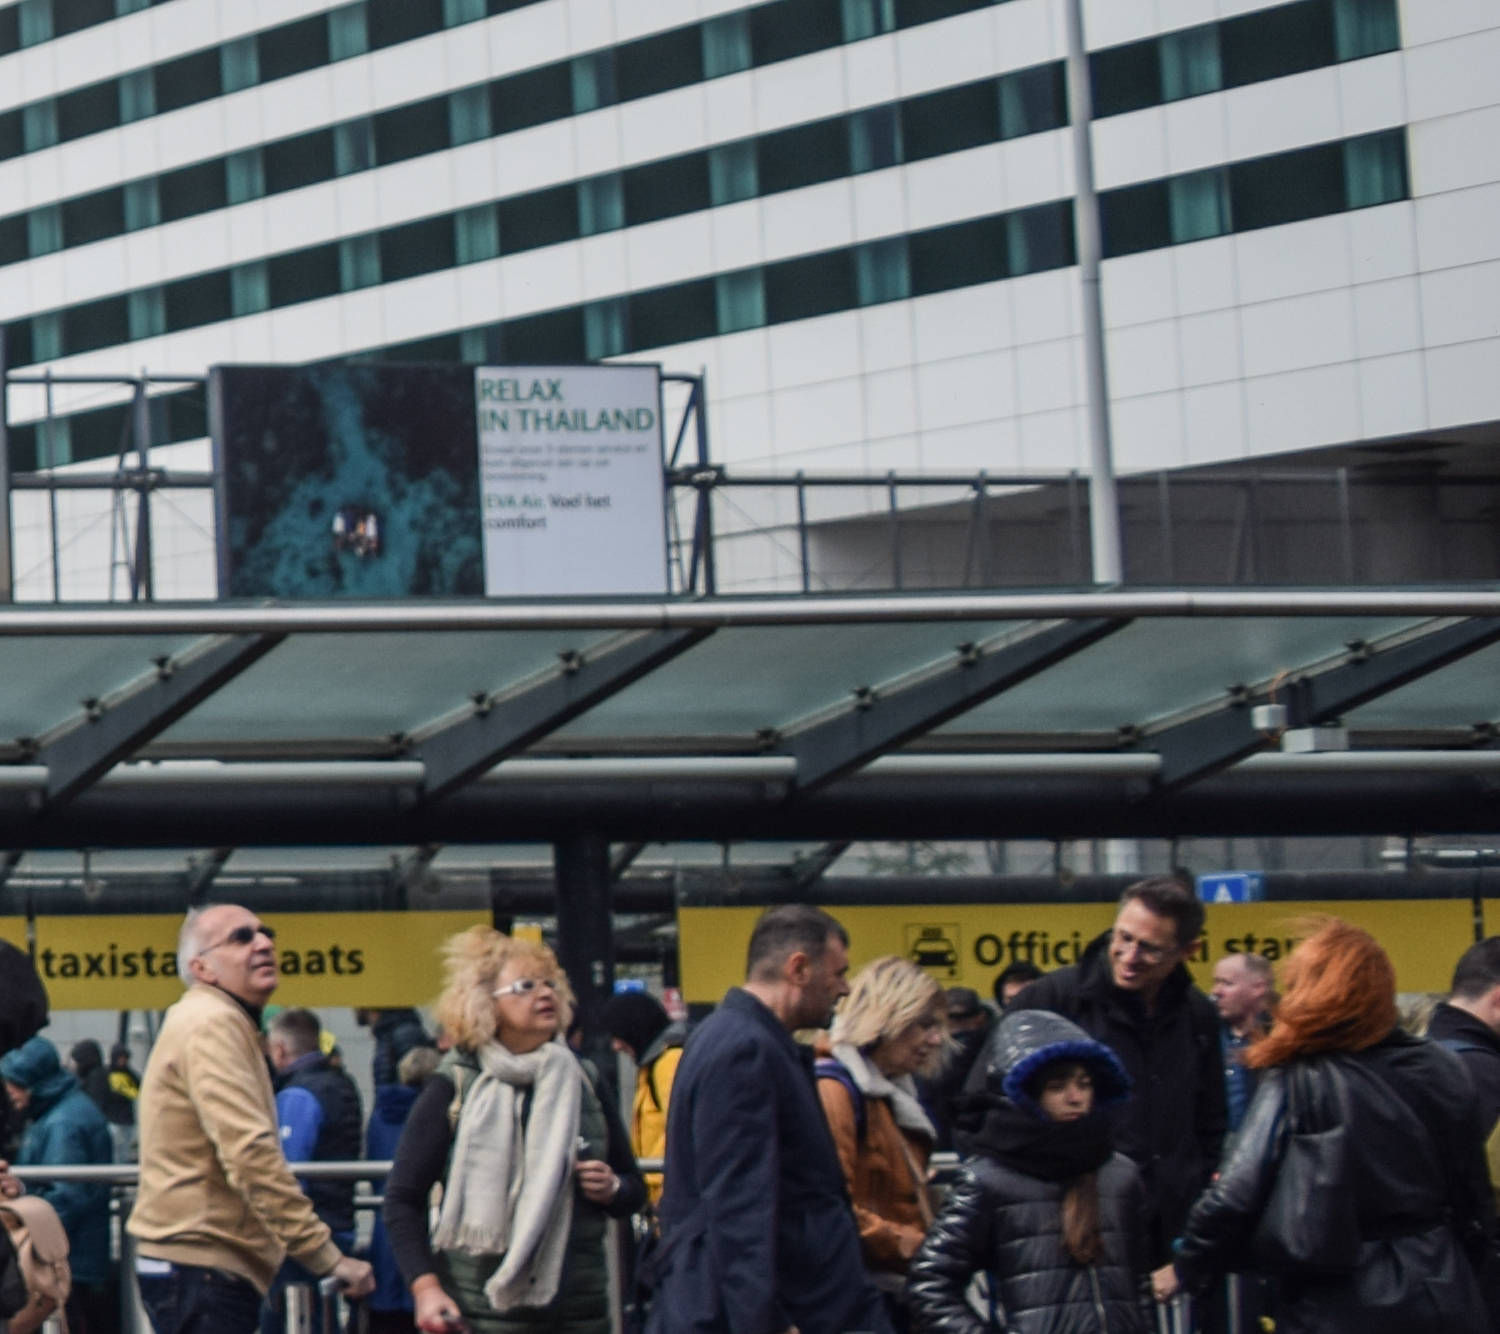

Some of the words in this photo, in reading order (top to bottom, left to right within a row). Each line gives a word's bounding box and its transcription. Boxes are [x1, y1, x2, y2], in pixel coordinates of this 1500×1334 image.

[479, 378, 563, 402] RELAX
[479, 409, 510, 432] IN
[517, 407, 655, 433] THAILAND
[41, 944, 365, 978] taxistaaats
[974, 929, 1082, 966] Offici
